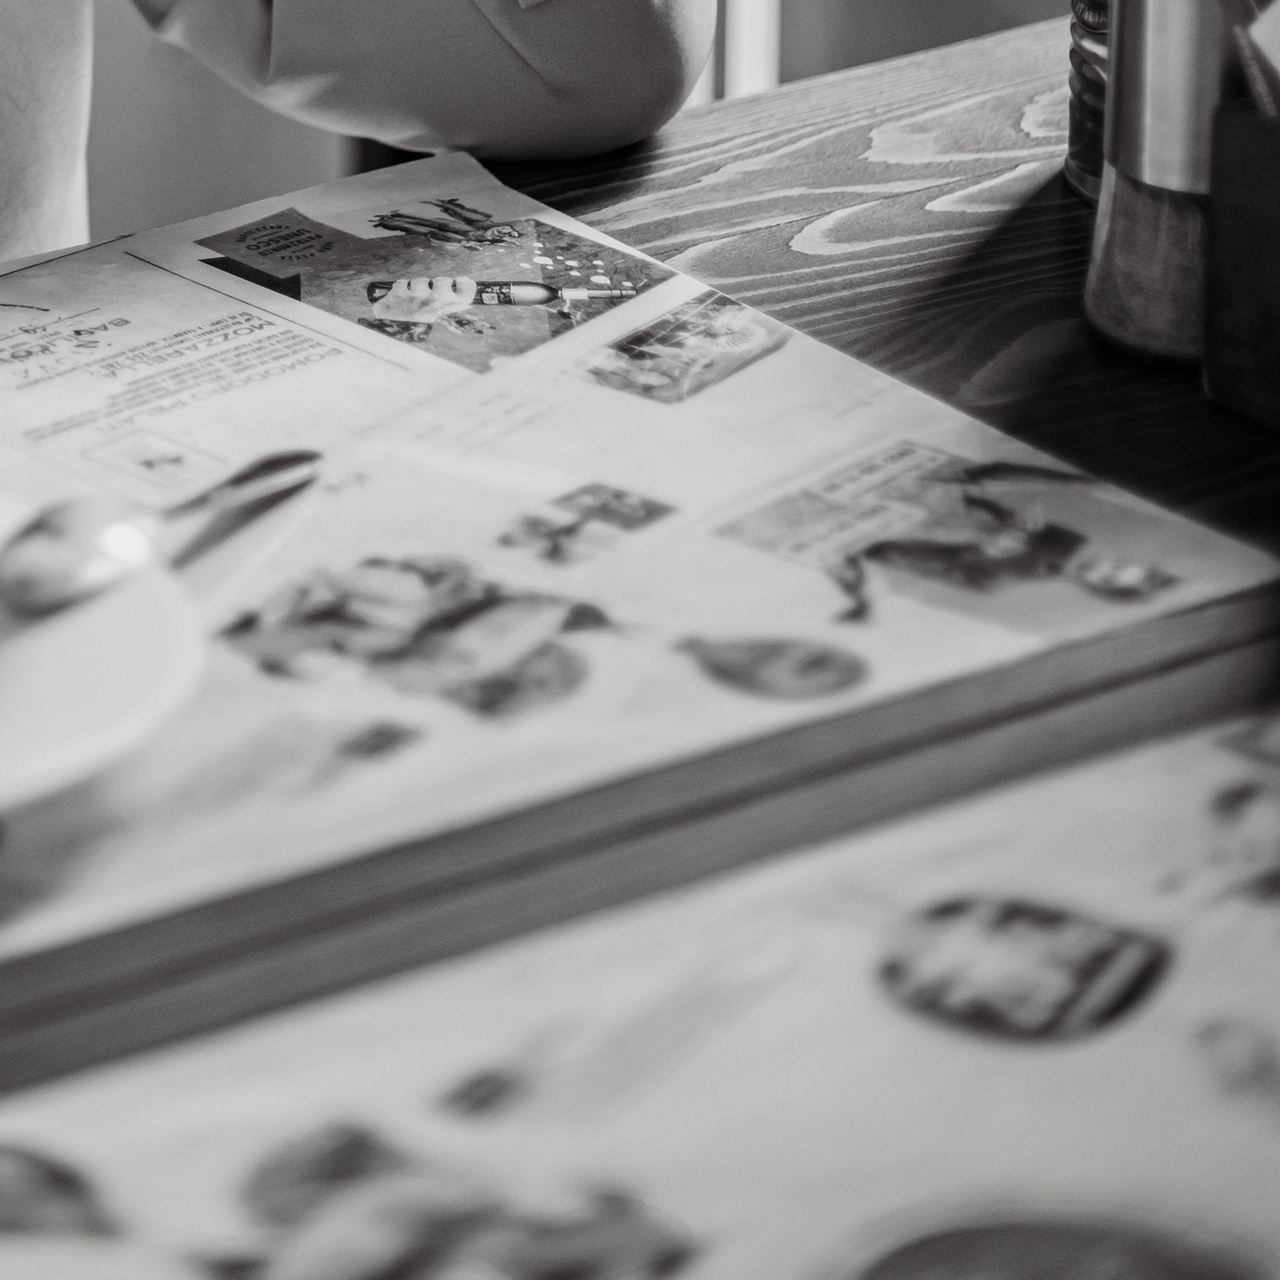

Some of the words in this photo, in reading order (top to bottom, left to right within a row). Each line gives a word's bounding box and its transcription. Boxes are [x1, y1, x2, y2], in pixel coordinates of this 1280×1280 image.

[245, 228, 313, 252] UNESCO
[100, 319, 277, 379] MOZZARELLA
[189, 346, 343, 402] POMODORO
